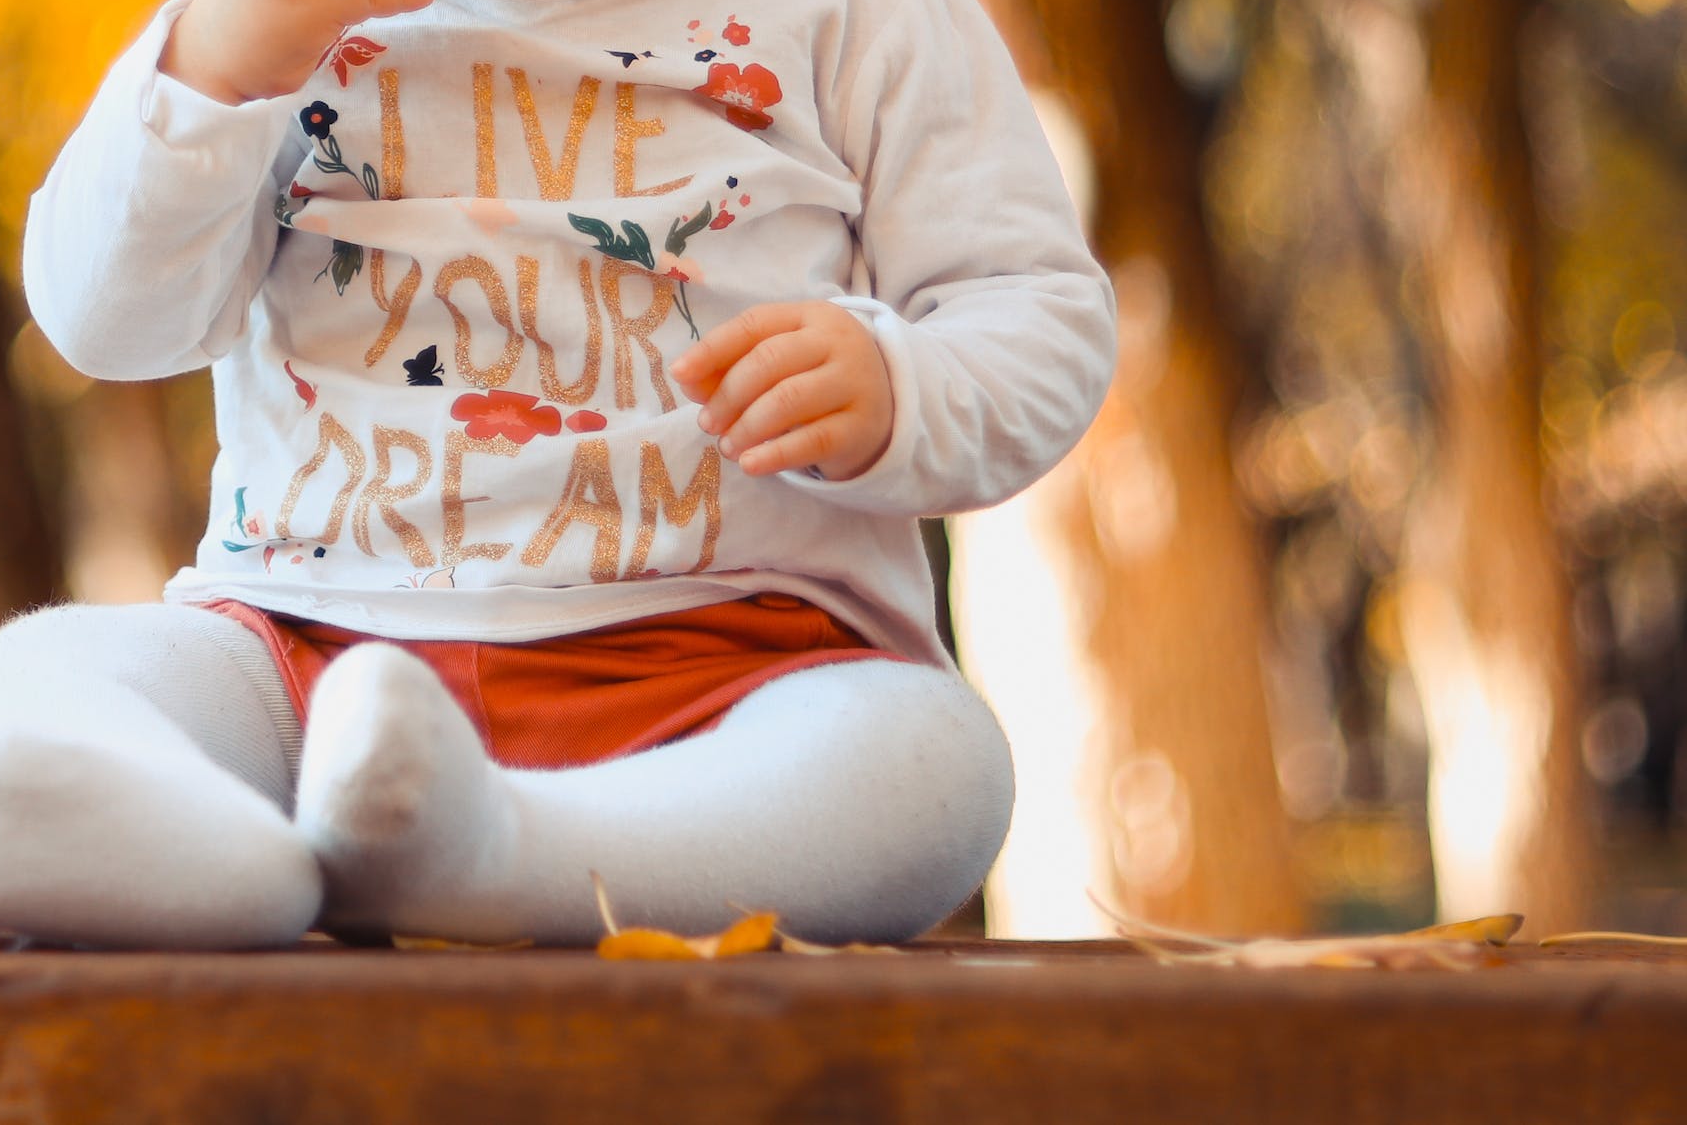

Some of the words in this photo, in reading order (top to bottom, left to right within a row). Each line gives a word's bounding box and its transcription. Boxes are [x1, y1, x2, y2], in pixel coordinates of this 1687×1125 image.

[378, 61, 696, 202] LIVE
[364, 248, 677, 413] YOUR
[275, 411, 722, 585] DREAM
